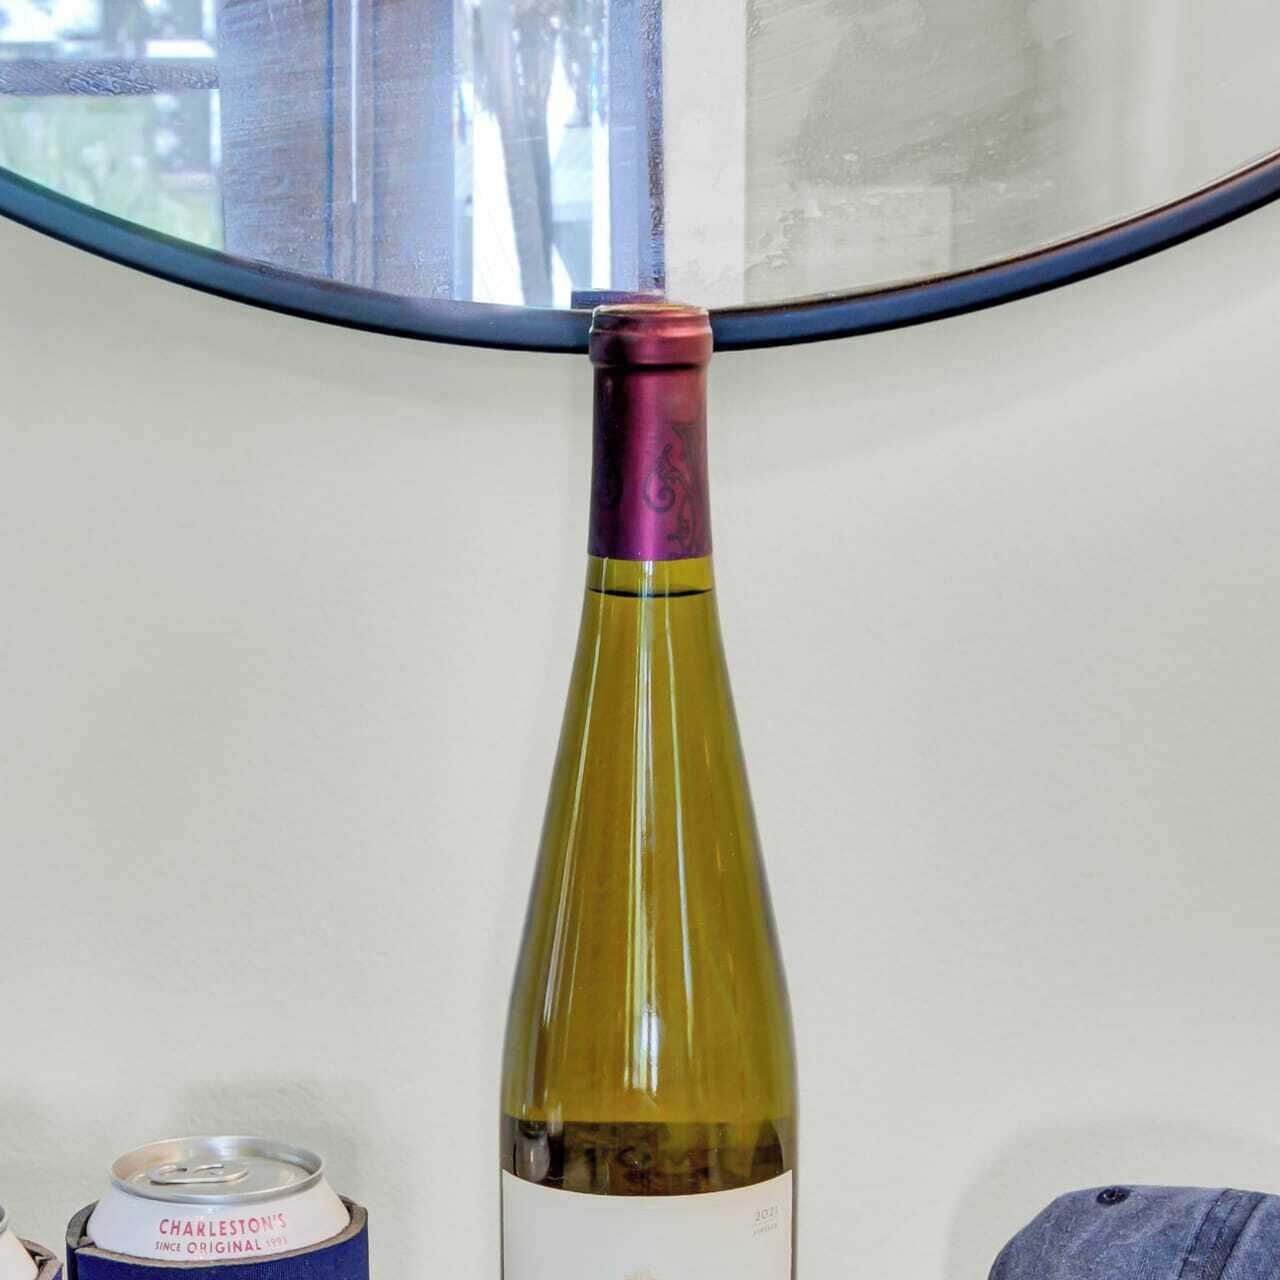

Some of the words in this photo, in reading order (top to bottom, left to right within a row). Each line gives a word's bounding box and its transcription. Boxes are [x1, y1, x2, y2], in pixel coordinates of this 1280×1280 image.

[158, 1213, 288, 1238] CHARLESTON'S
[155, 1240, 181, 1253] SINCE
[186, 1238, 263, 1255] ORIGINAL
